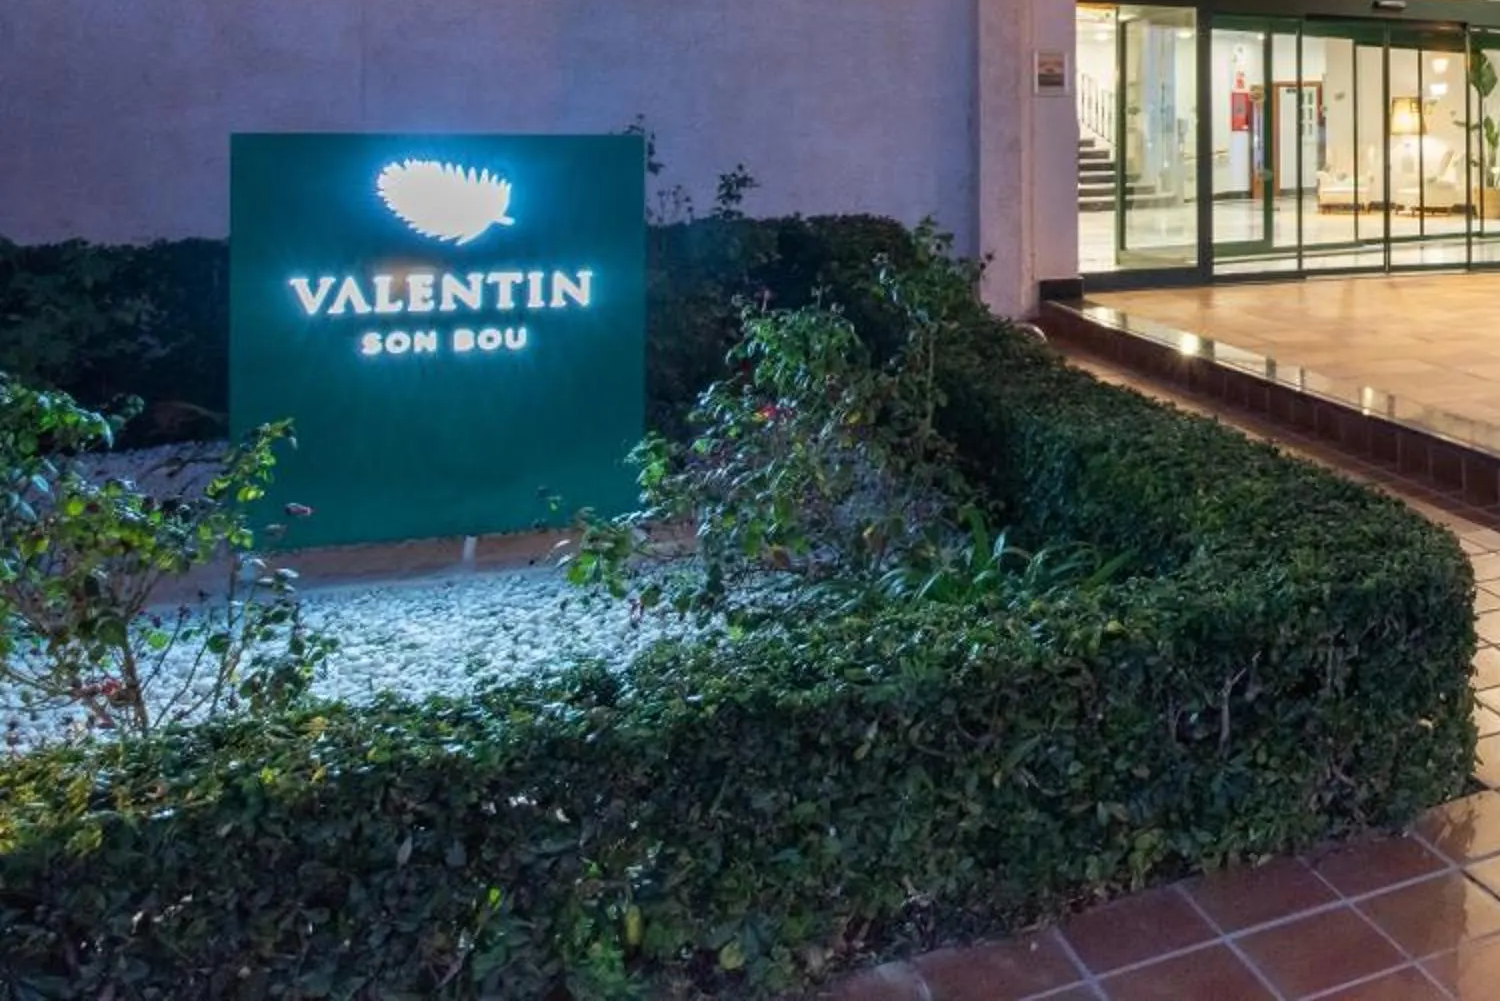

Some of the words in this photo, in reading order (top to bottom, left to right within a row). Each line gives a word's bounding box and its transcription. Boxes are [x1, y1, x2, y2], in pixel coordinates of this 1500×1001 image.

[289, 270, 593, 315] VALENTIN
[361, 330, 438, 355] SON
[453, 326, 528, 350] BOU
